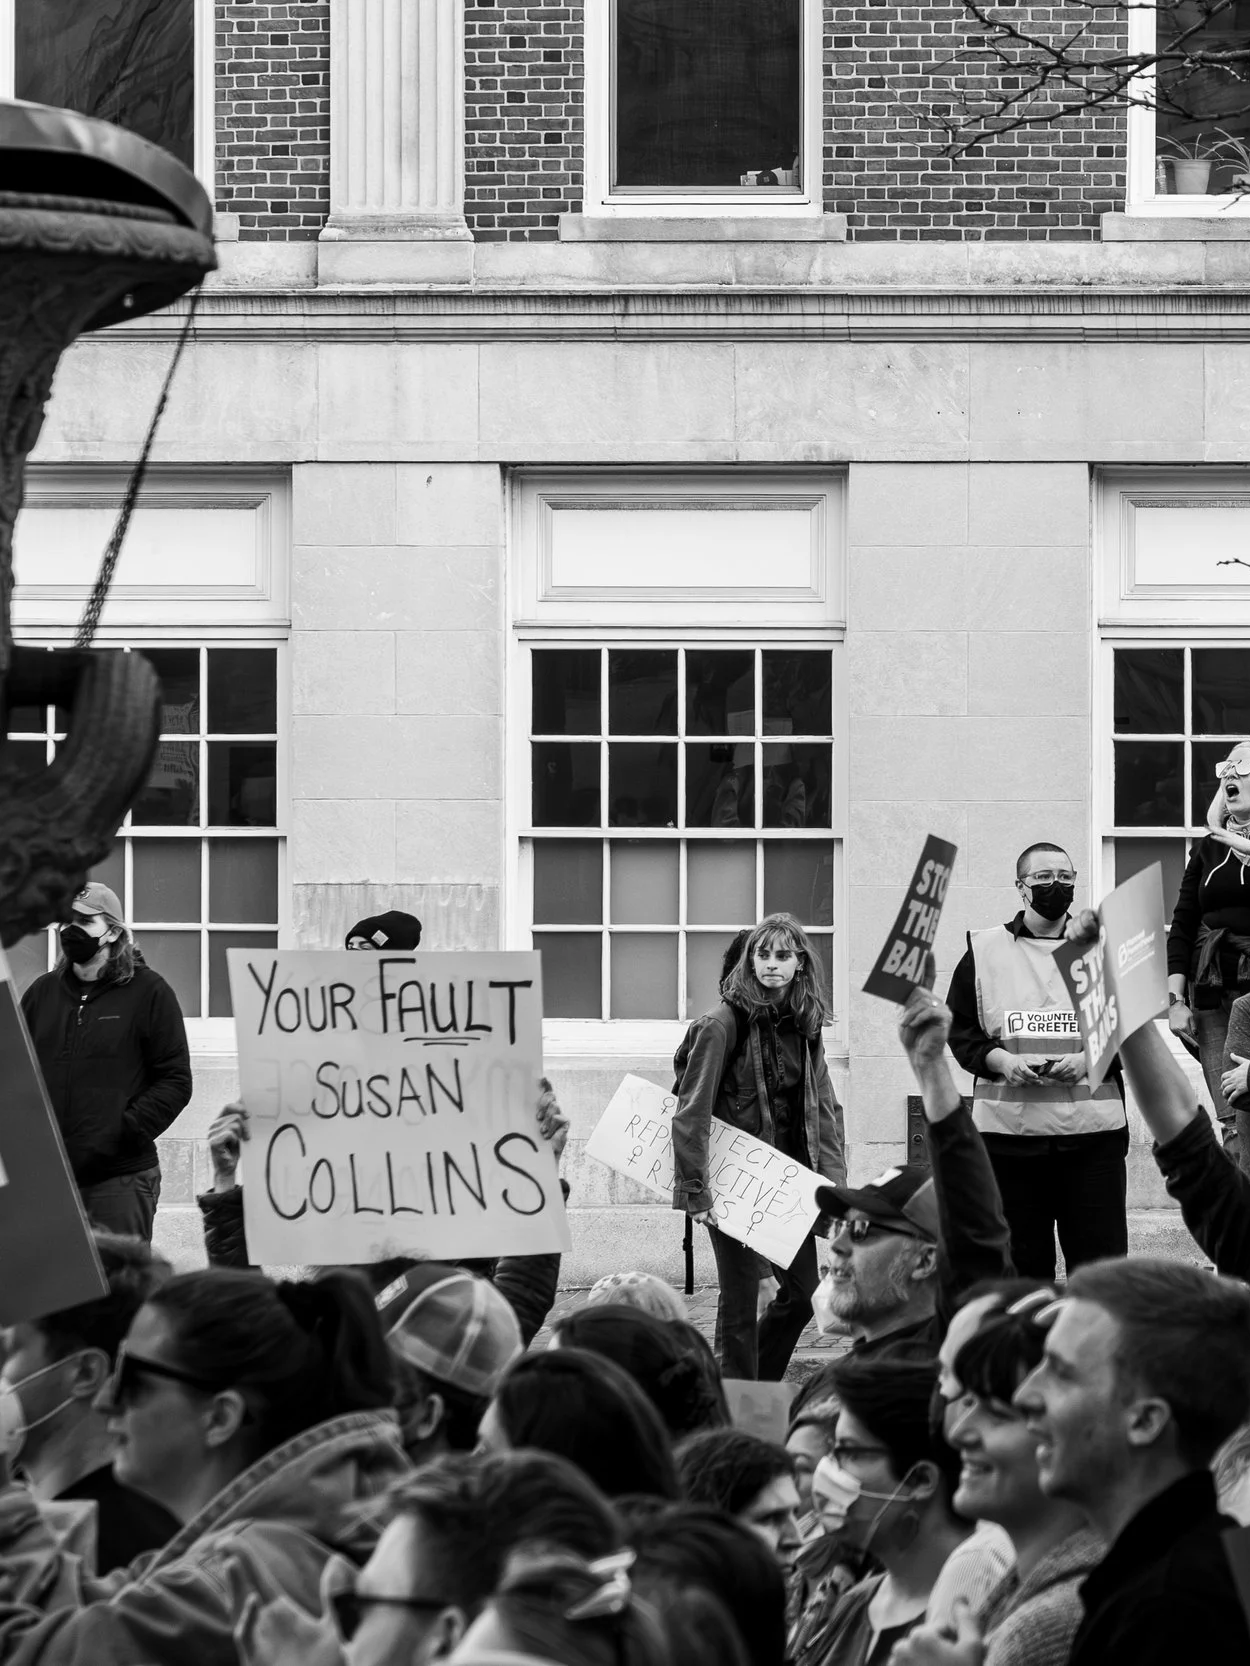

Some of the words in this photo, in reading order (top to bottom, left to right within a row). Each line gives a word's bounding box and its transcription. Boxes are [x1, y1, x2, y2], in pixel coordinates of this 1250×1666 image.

[916, 859, 952, 903] STO
[881, 939, 930, 984] BA
[247, 959, 358, 1036] YOUR
[378, 957, 534, 1045] FAULT
[1027, 1013, 1078, 1023] VOLUNTEE
[311, 1057, 464, 1119] SUSAN
[265, 1122, 546, 1221] COLLINS
[624, 1113, 790, 1217] REPRUCTIVE
[646, 1158, 737, 1220] RITS
